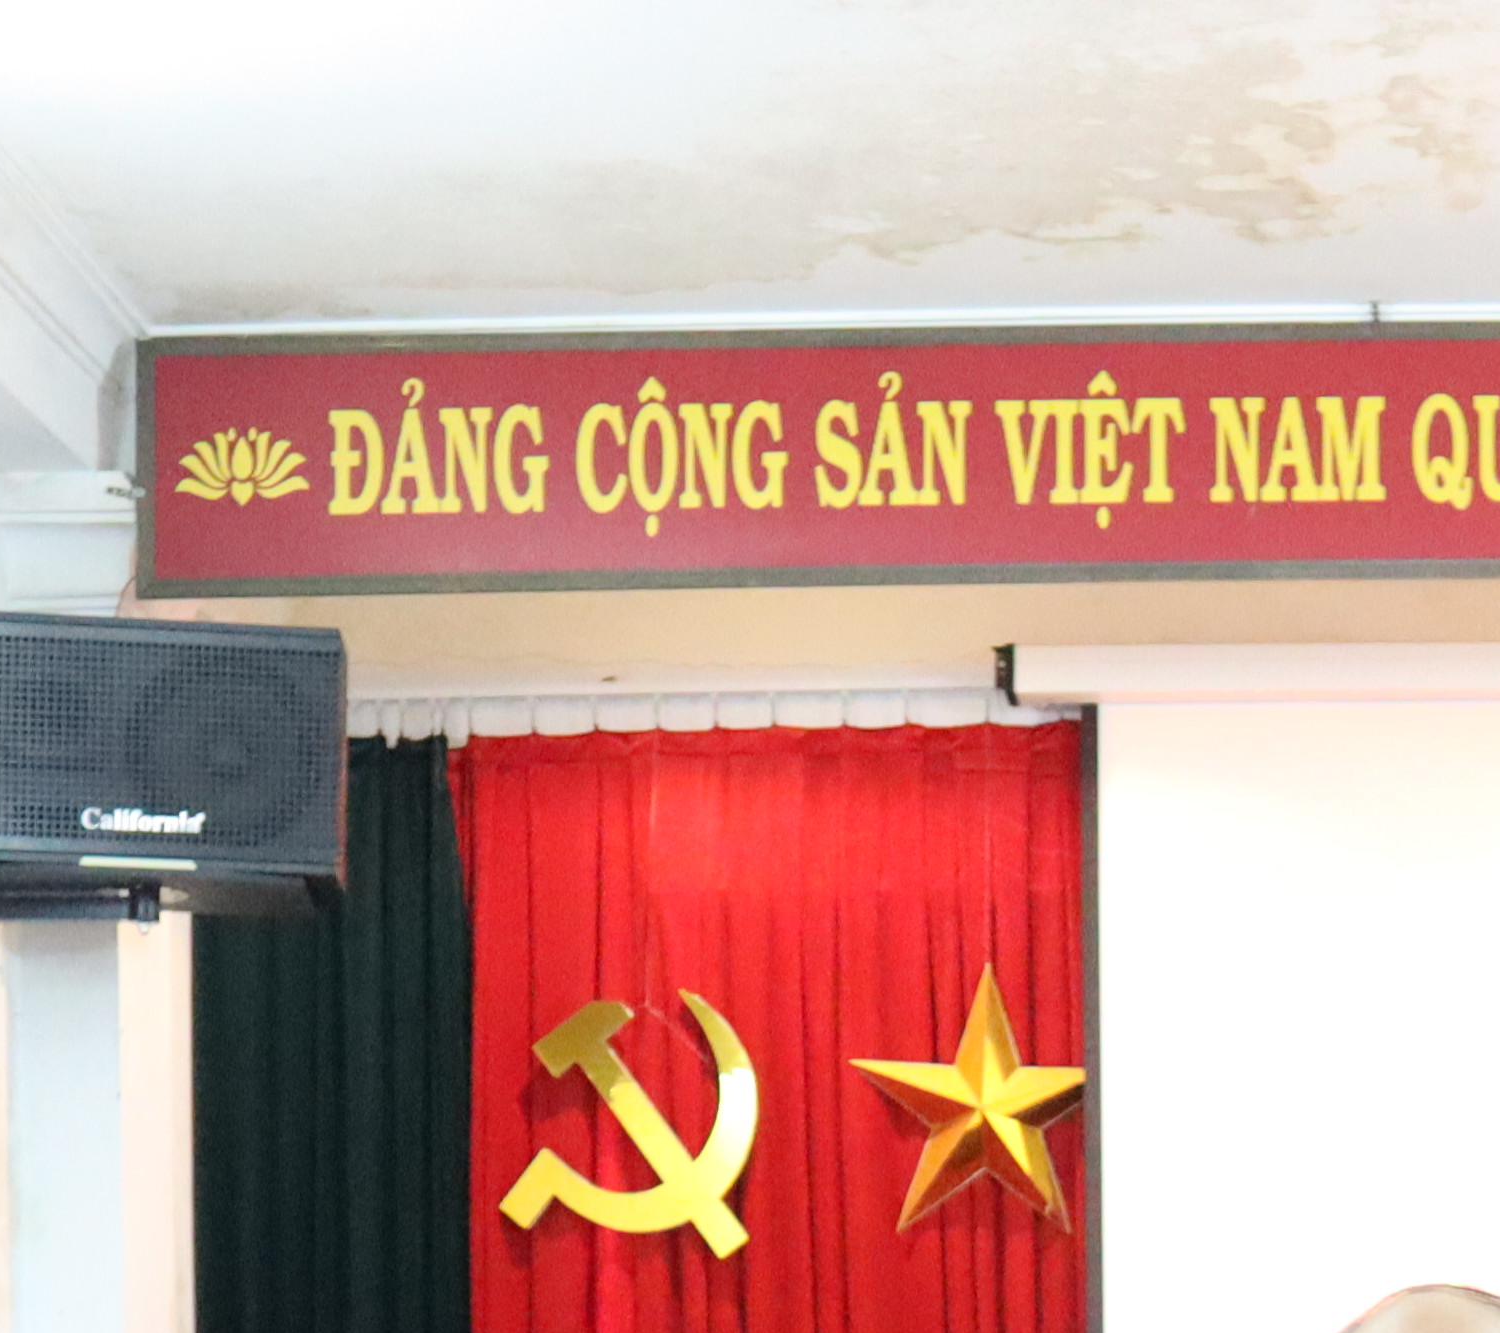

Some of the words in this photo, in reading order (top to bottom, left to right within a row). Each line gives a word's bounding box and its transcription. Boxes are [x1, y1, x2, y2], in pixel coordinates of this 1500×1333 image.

[328, 376, 551, 516] ĐẢNG
[575, 375, 789, 538] CỘNG
[814, 371, 973, 510] SẢN
[994, 369, 1186, 530] VIỆT
[1209, 395, 1387, 504] NAM
[80, 806, 206, 834] California
